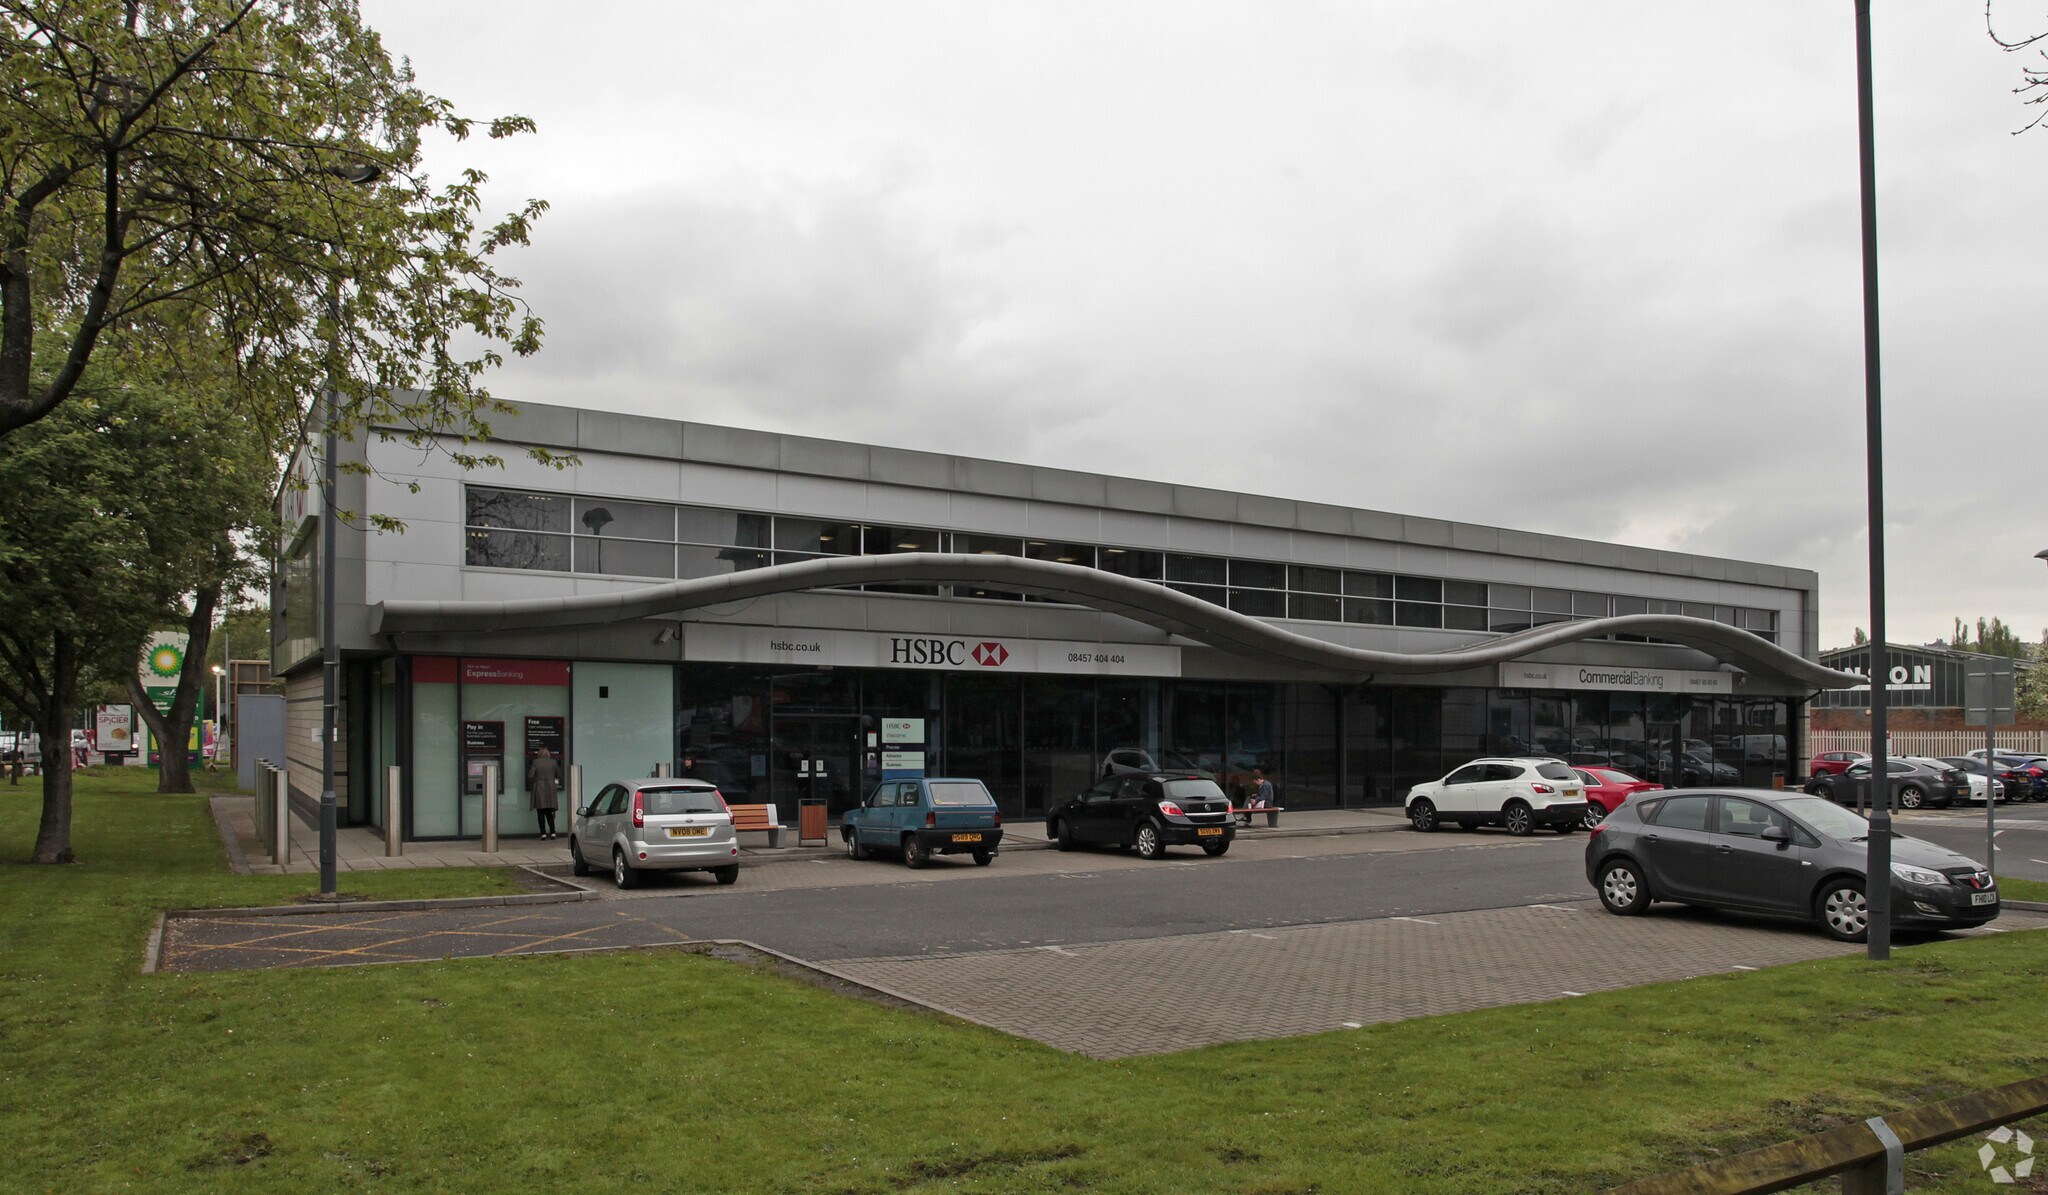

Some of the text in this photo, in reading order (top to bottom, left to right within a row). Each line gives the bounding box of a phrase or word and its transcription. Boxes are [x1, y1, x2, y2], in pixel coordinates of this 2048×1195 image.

[770, 640, 821, 652] hsbc.co.uk
[890, 637, 966, 666] HSBC
[1068, 653, 1125, 664] 08457 404 404
[466, 669, 523, 679] ExpressBanking
[1524, 672, 1547, 680] hsbc.co.uk
[1579, 668, 1664, 689] CommercialBanking
